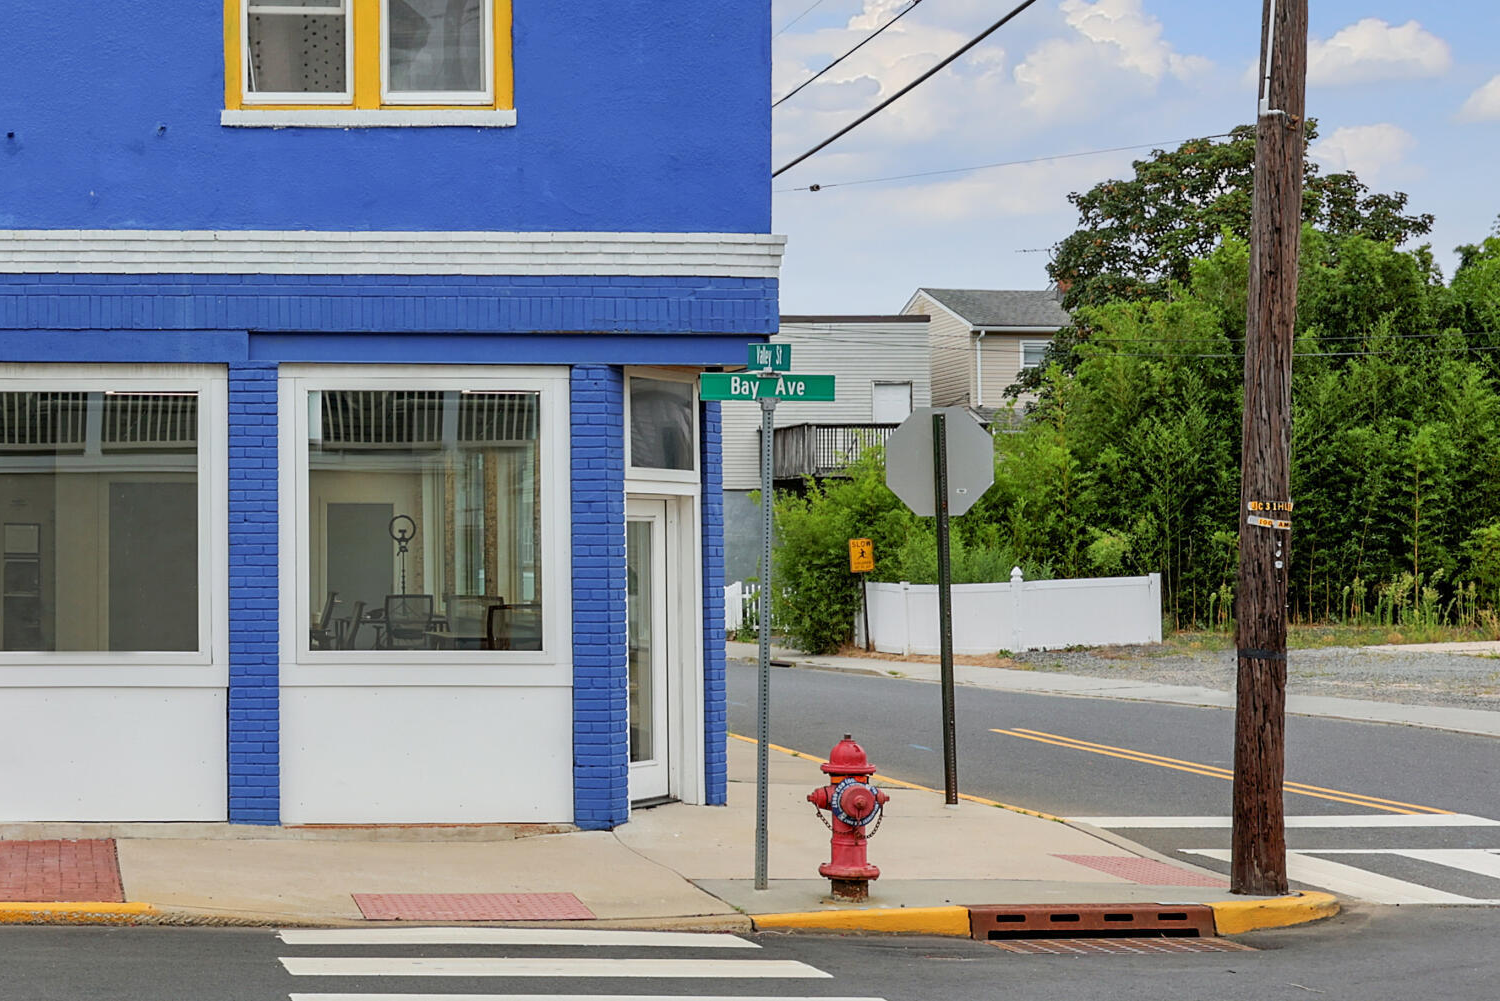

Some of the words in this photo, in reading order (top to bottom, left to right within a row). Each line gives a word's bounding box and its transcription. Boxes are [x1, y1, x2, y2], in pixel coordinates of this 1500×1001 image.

[756, 345, 772, 367] Valley
[776, 345, 782, 365] St
[731, 376, 760, 400] Bay
[775, 376, 805, 396] Ave
